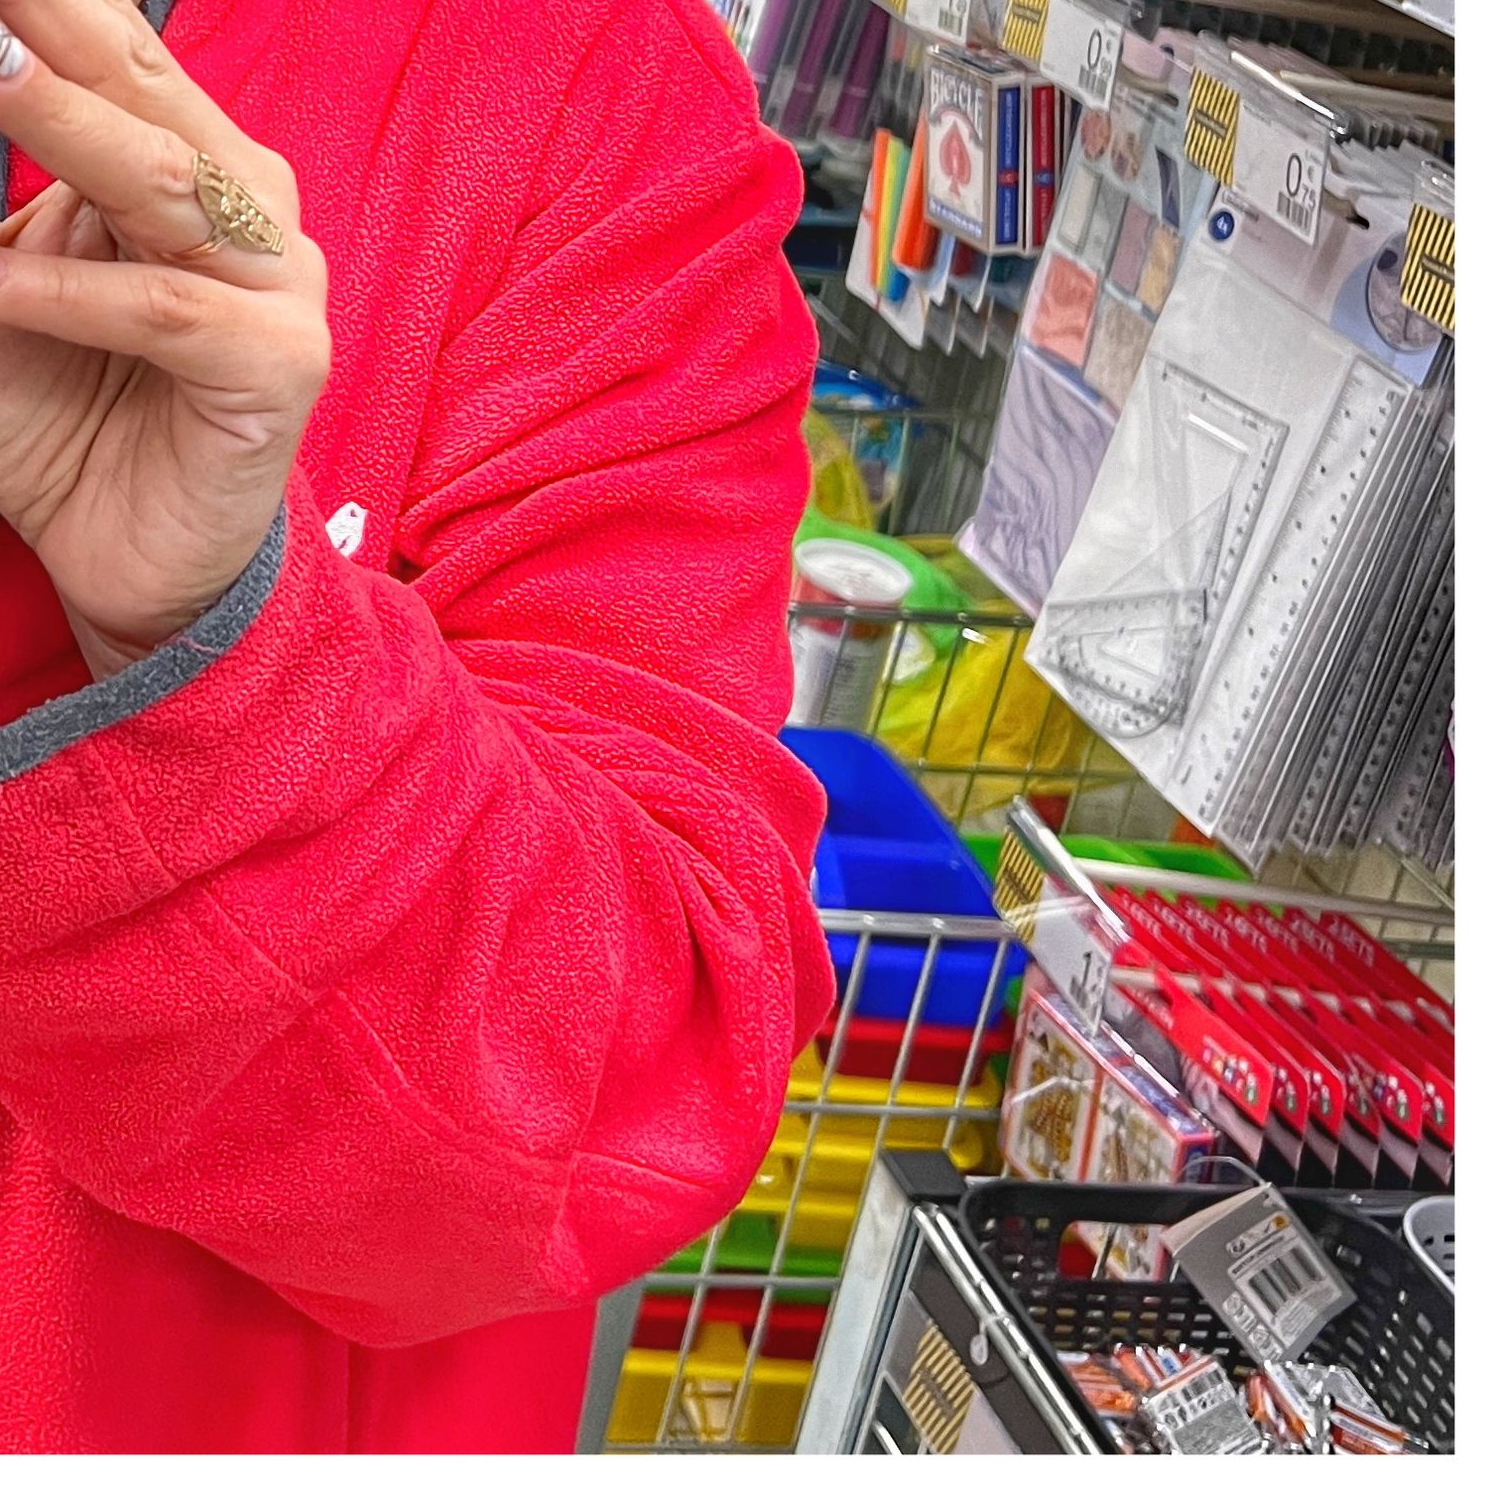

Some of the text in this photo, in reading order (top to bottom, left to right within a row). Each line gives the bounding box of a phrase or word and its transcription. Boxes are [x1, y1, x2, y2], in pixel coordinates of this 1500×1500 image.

[1087, 28, 1102, 69] 0
[930, 66, 983, 141] BICYCLE
[1286, 153, 1302, 197] 0
[1302, 183, 1317, 213] 75
